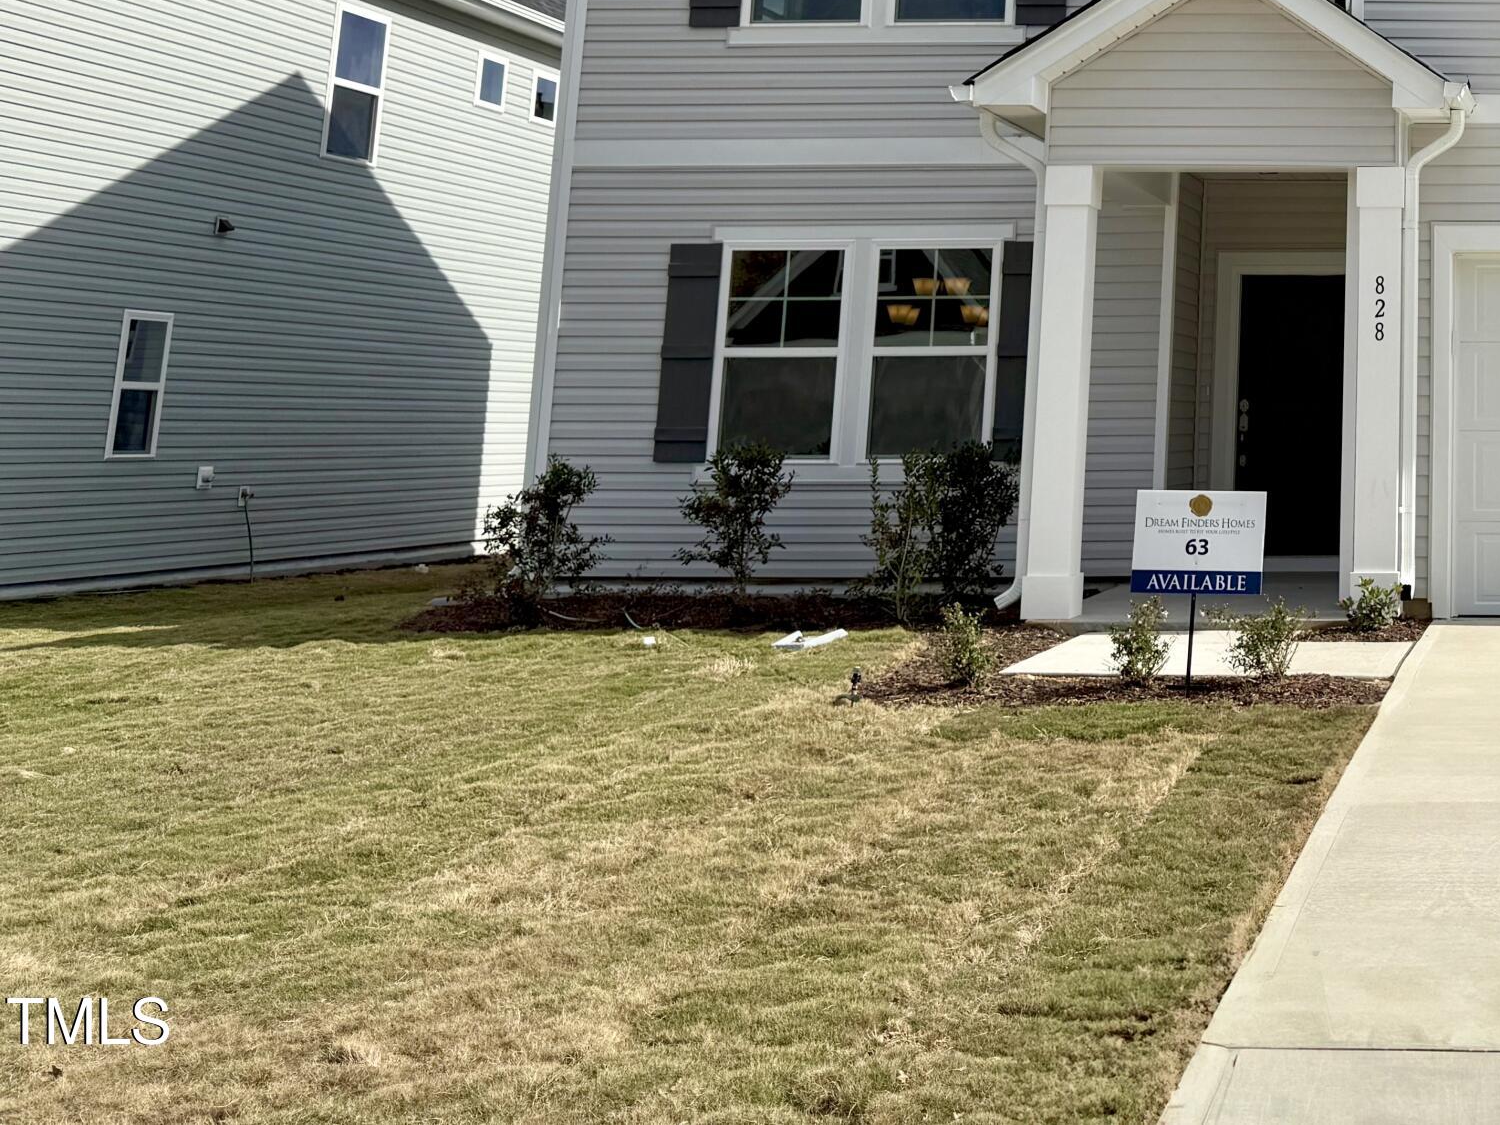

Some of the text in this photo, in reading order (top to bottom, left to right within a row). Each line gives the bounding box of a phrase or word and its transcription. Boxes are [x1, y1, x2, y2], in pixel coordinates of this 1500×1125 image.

[1375, 275, 1385, 341] 828
[1145, 517, 1256, 529] DREAM FINDERS HOMES
[1185, 539, 1209, 555] 63
[1146, 574, 1247, 591] AVAILABLE
